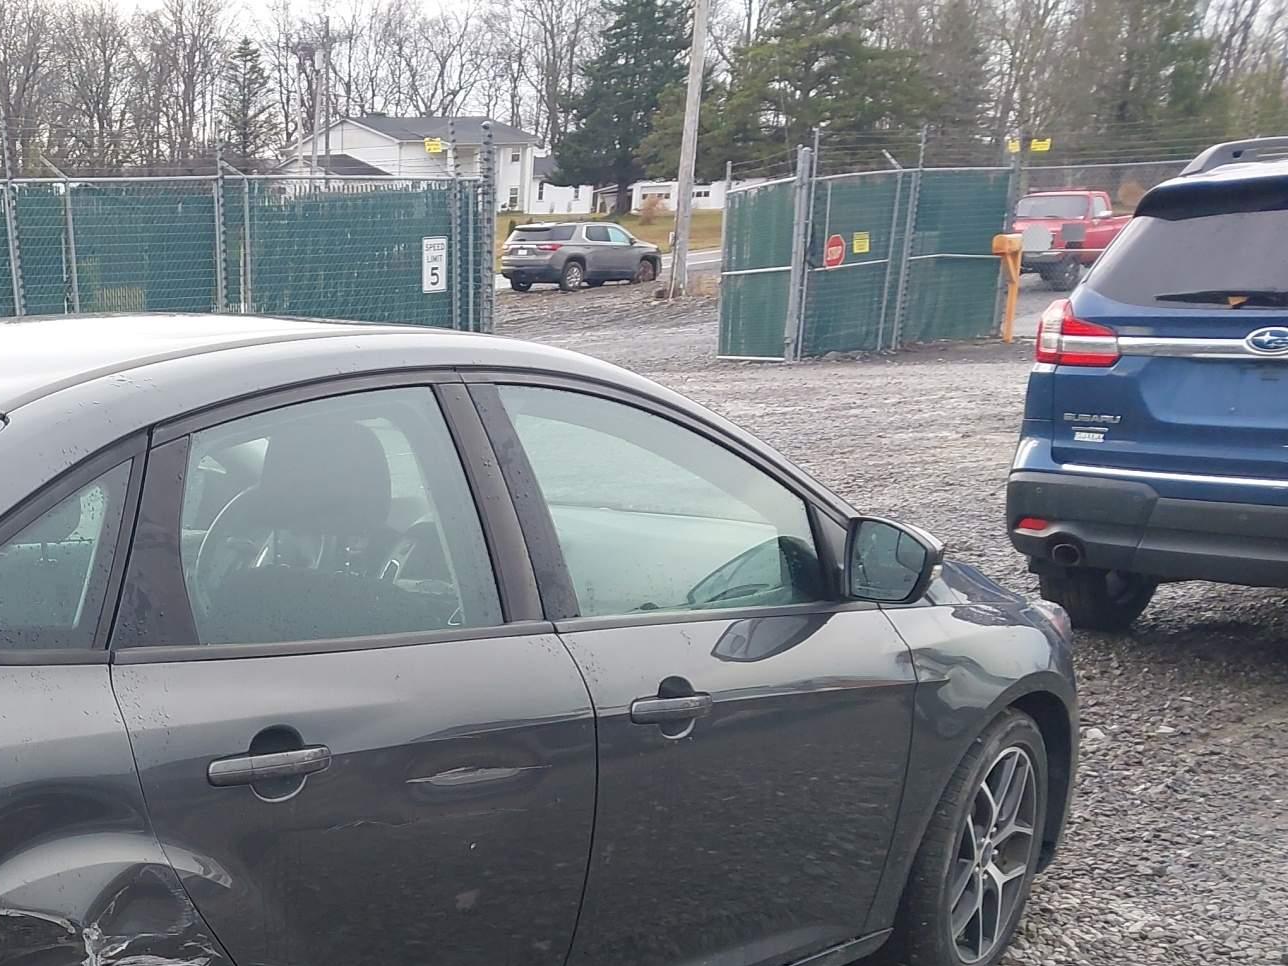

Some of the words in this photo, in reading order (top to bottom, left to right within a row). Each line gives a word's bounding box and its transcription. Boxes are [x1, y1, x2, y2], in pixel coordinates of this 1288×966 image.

[425, 243, 445, 251] SPEED
[426, 254, 444, 263] LIMIT
[430, 266, 440, 286] 5
[1063, 412, 1122, 424] SUBARU
